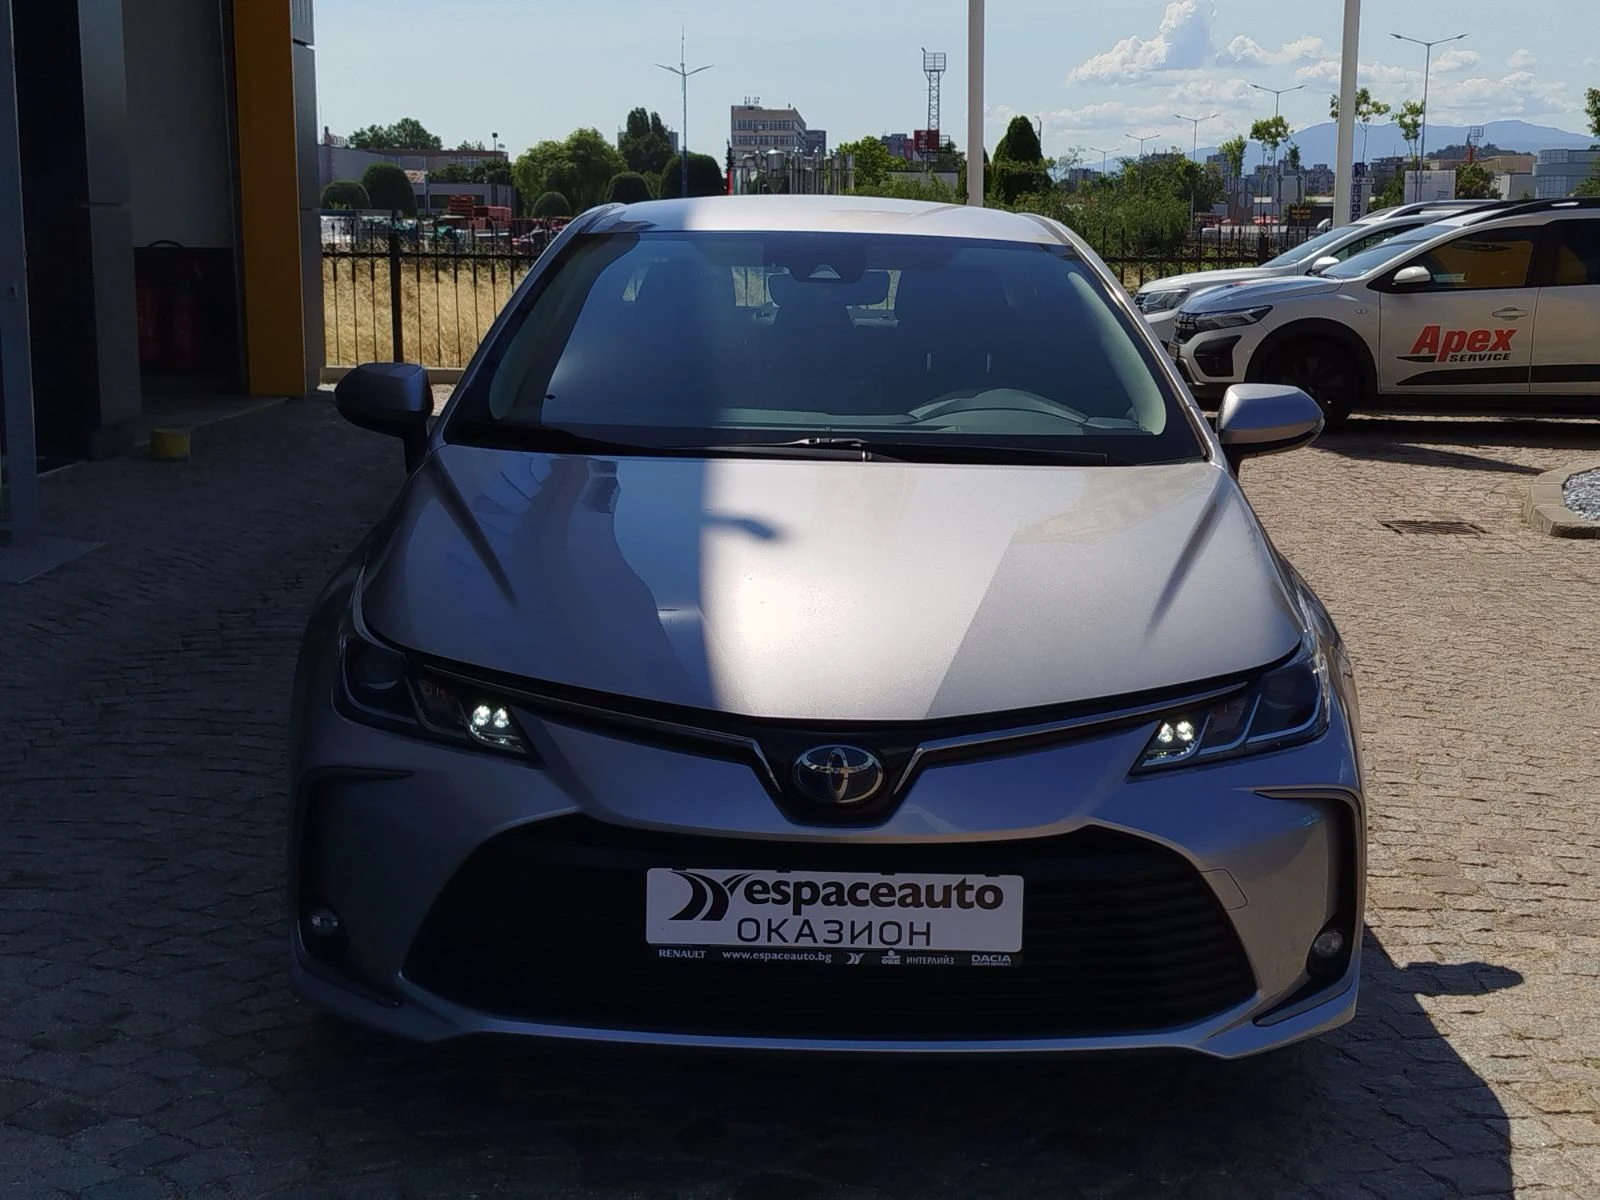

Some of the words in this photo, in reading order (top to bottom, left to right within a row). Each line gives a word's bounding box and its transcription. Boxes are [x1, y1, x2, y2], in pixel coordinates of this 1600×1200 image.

[1410, 325, 1518, 363] Apex
[1448, 352, 1512, 363] SERVICE
[743, 876, 1004, 916] espaceauto
[737, 917, 931, 946] ОКАЗИОН
[658, 949, 707, 959] RENAULT
[722, 951, 832, 963] www.espaceauto.bg
[906, 954, 955, 965] ИНТЕРЛИЙЗ
[971, 954, 1012, 962] DACIA
